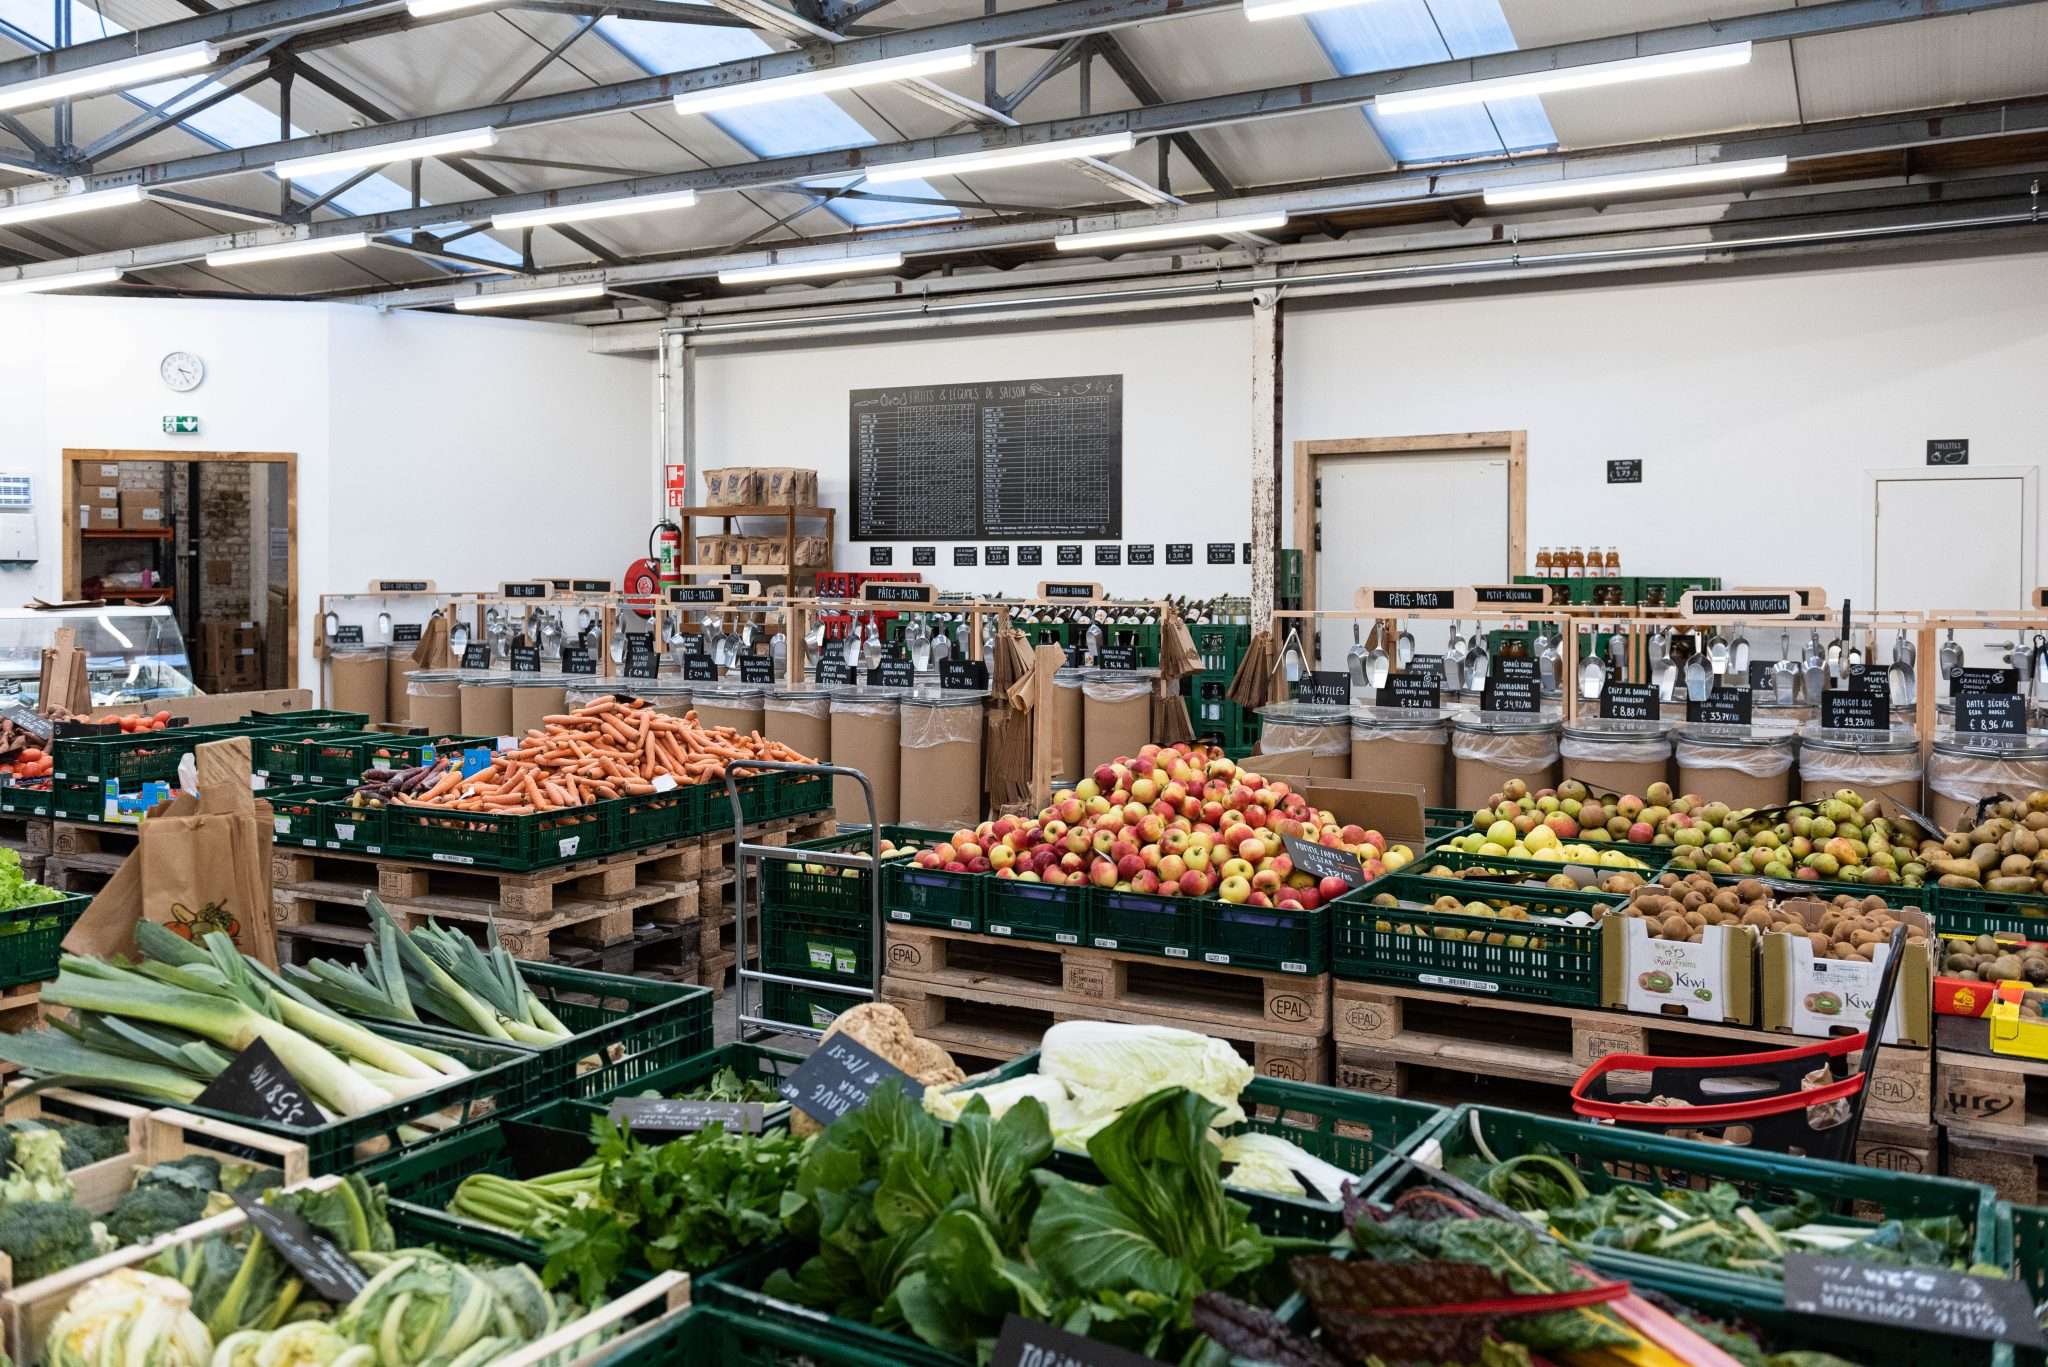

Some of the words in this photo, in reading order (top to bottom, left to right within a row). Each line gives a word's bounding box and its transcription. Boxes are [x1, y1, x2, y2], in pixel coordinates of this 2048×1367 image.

[699, 589, 716, 602] PASTA
[901, 588, 921, 601] PASTA
[1389, 592, 1411, 607] PÂTES
[1416, 593, 1438, 606] PASTA
[1694, 599, 1747, 612] GEDROOGDEN
[1750, 598, 1788, 612] VRUCHTEN
[1970, 719, 1976, 730] €
[893, 949, 917, 964] EPAL
[1675, 971, 1705, 988] Kiwi
[1276, 997, 1305, 1018] EPAL
[1845, 992, 1874, 1009] Kiw
[1351, 1012, 1377, 1027] EPAL
[249, 1064, 276, 1092] /KG
[1270, 1063, 1301, 1080] EPAL
[1874, 1078, 1908, 1098] EPAL
[265, 1083, 305, 1125] 3,58
[810, 1084, 850, 1117] RAVE
